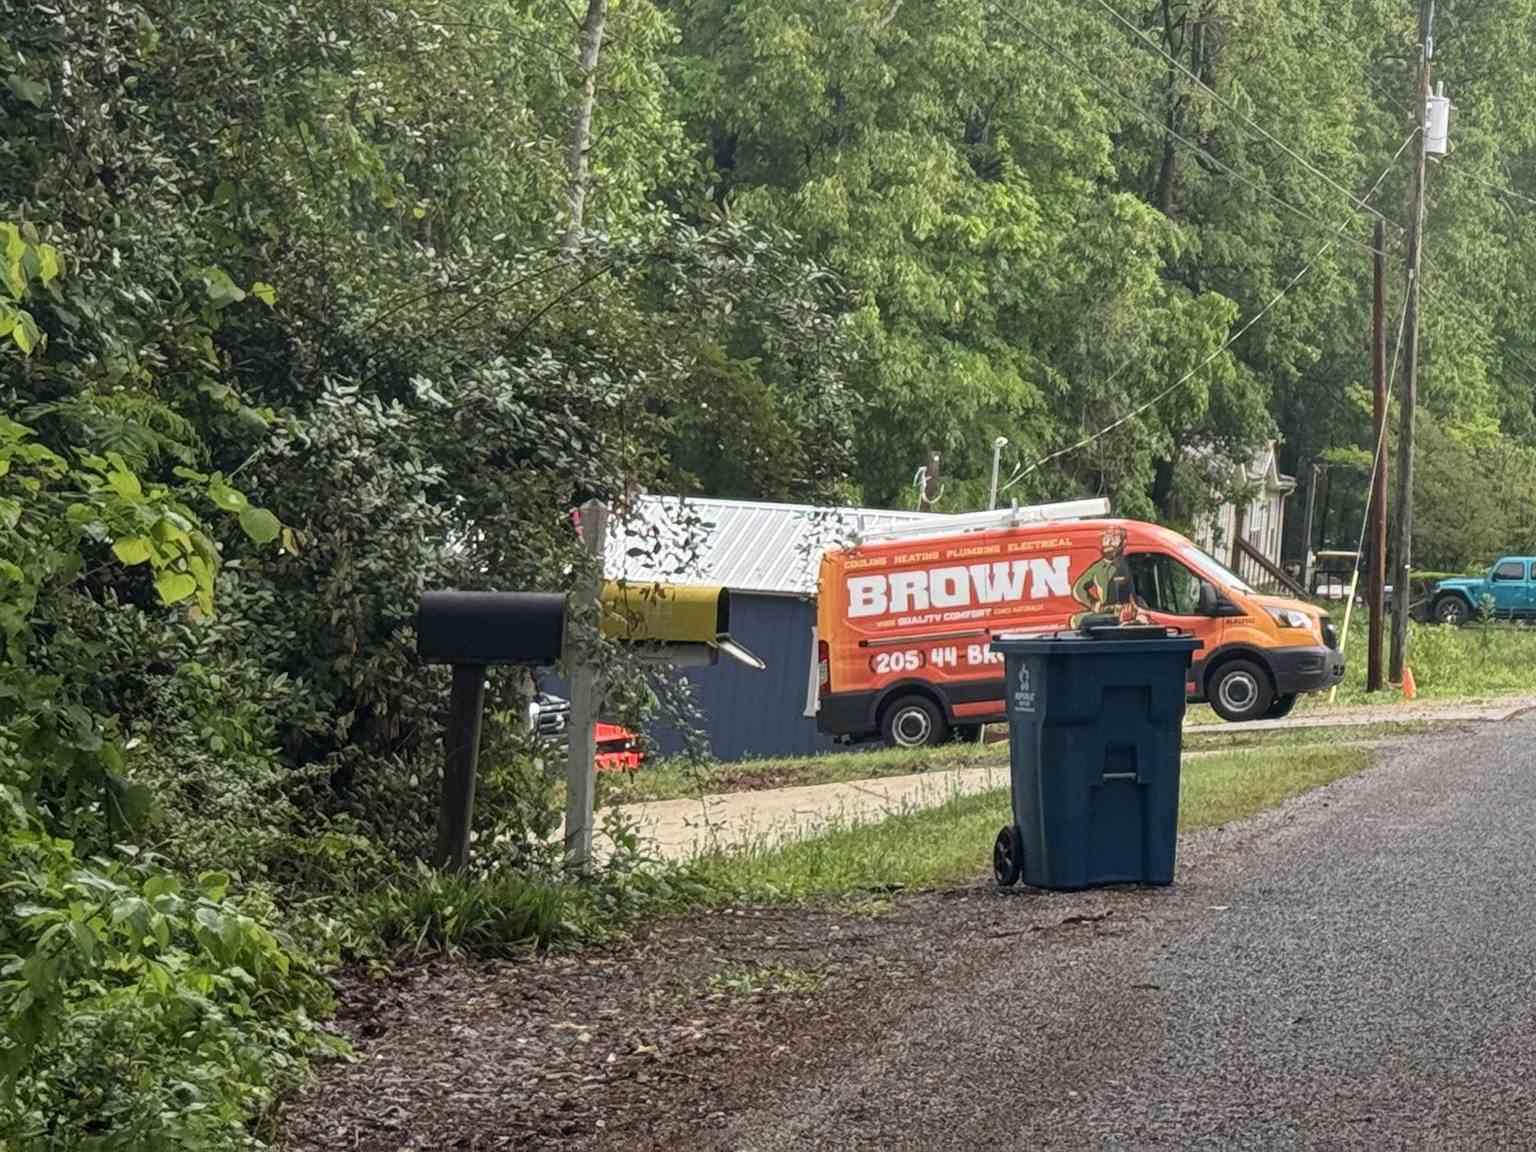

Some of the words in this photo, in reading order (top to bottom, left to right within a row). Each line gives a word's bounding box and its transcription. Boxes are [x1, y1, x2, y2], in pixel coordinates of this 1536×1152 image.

[894, 551, 939, 564] HEATING
[946, 544, 1001, 558] PLUMBING
[1008, 537, 1072, 551] ELECTRICAL
[847, 555, 1071, 618] BROWN
[897, 614, 942, 626] QUALITY
